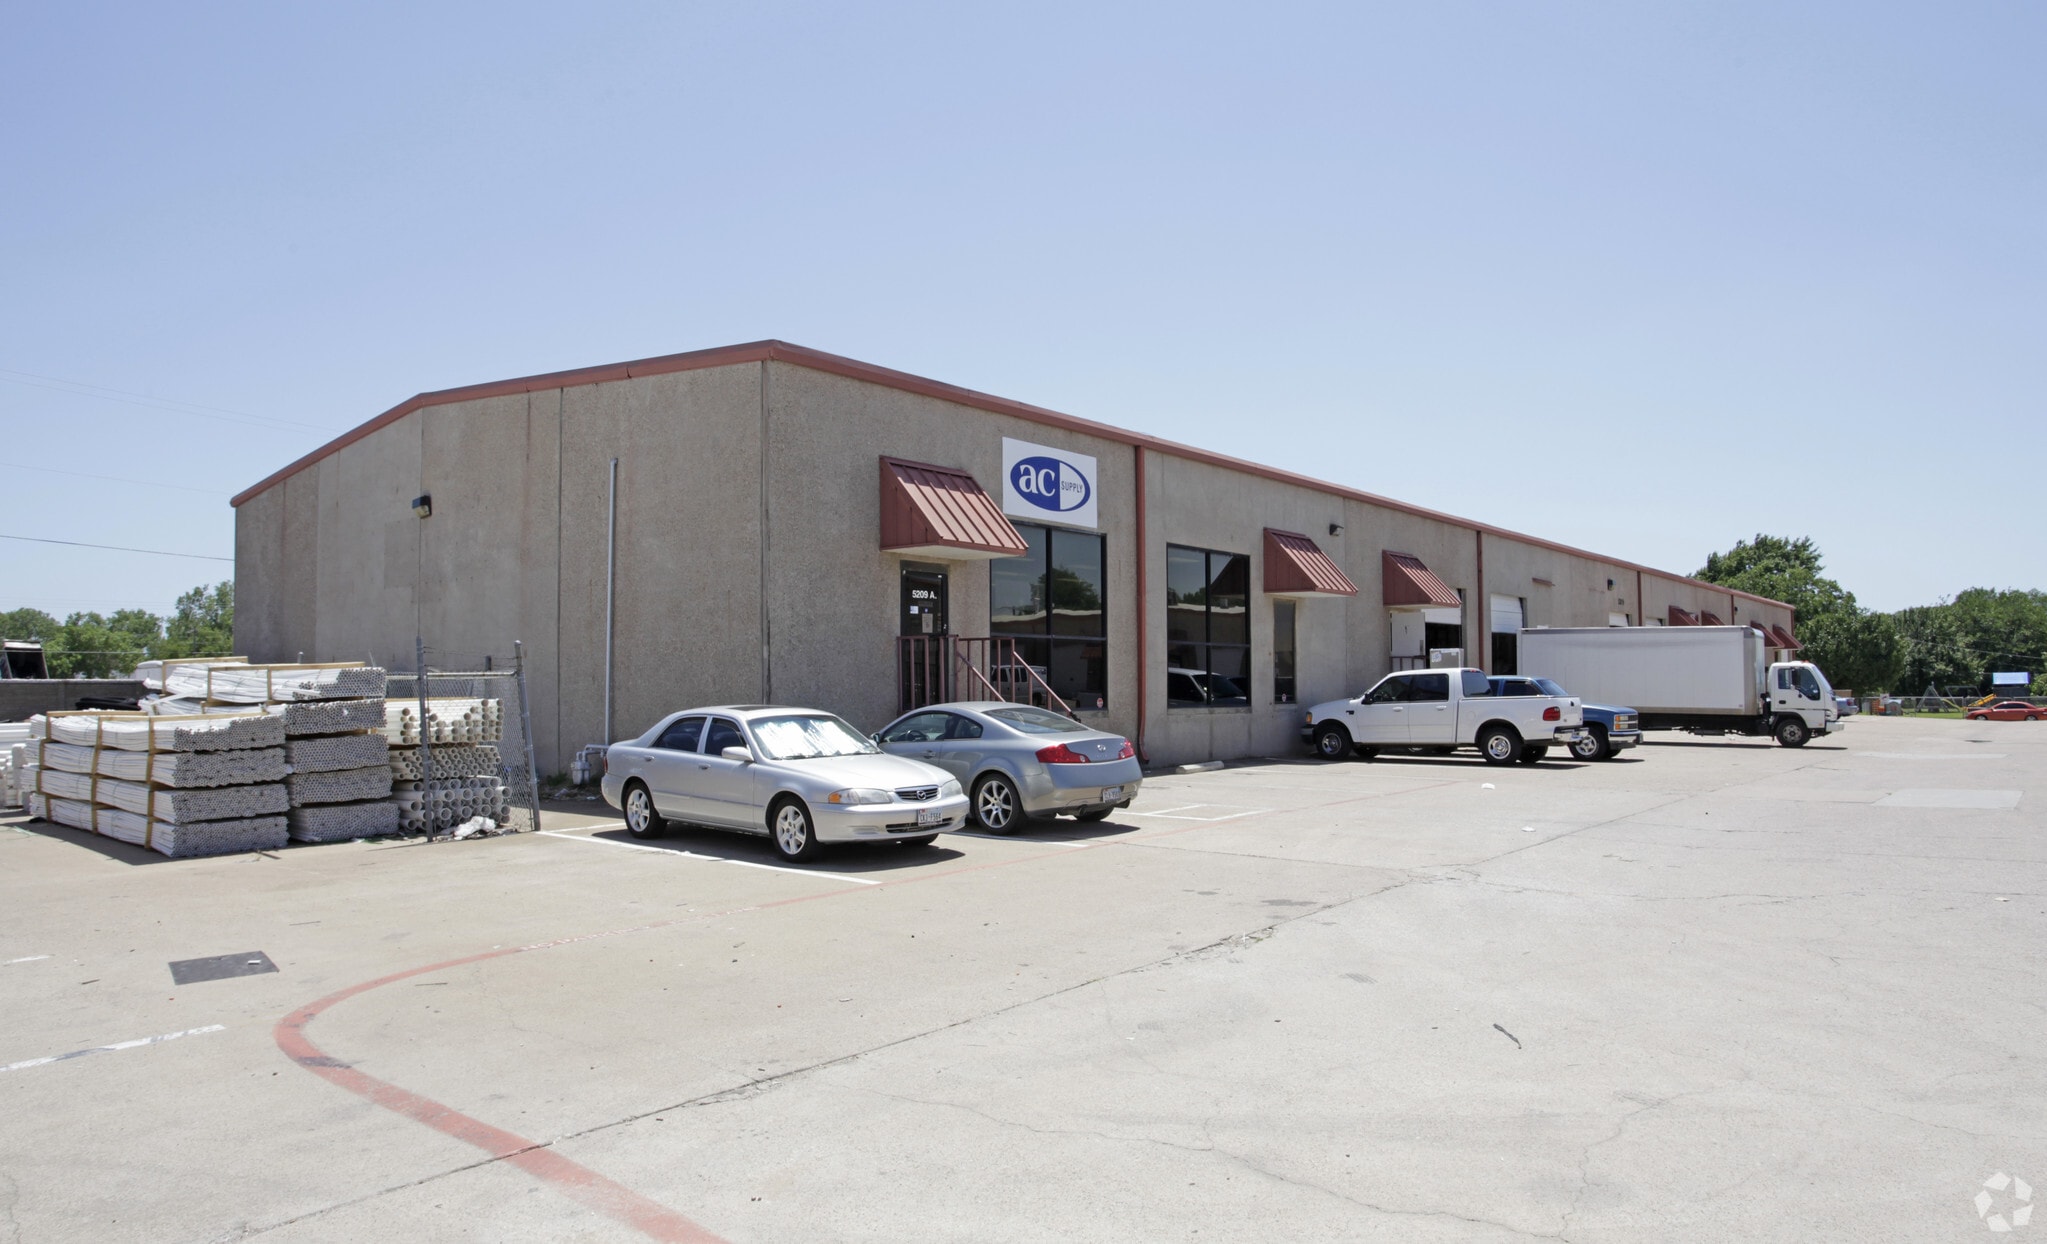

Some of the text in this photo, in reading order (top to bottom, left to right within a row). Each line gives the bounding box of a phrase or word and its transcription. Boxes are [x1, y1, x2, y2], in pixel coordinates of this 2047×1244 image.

[1018, 464, 1056, 497] ac
[1060, 480, 1083, 494] SUPPLY
[911, 590, 929, 599] 5209
